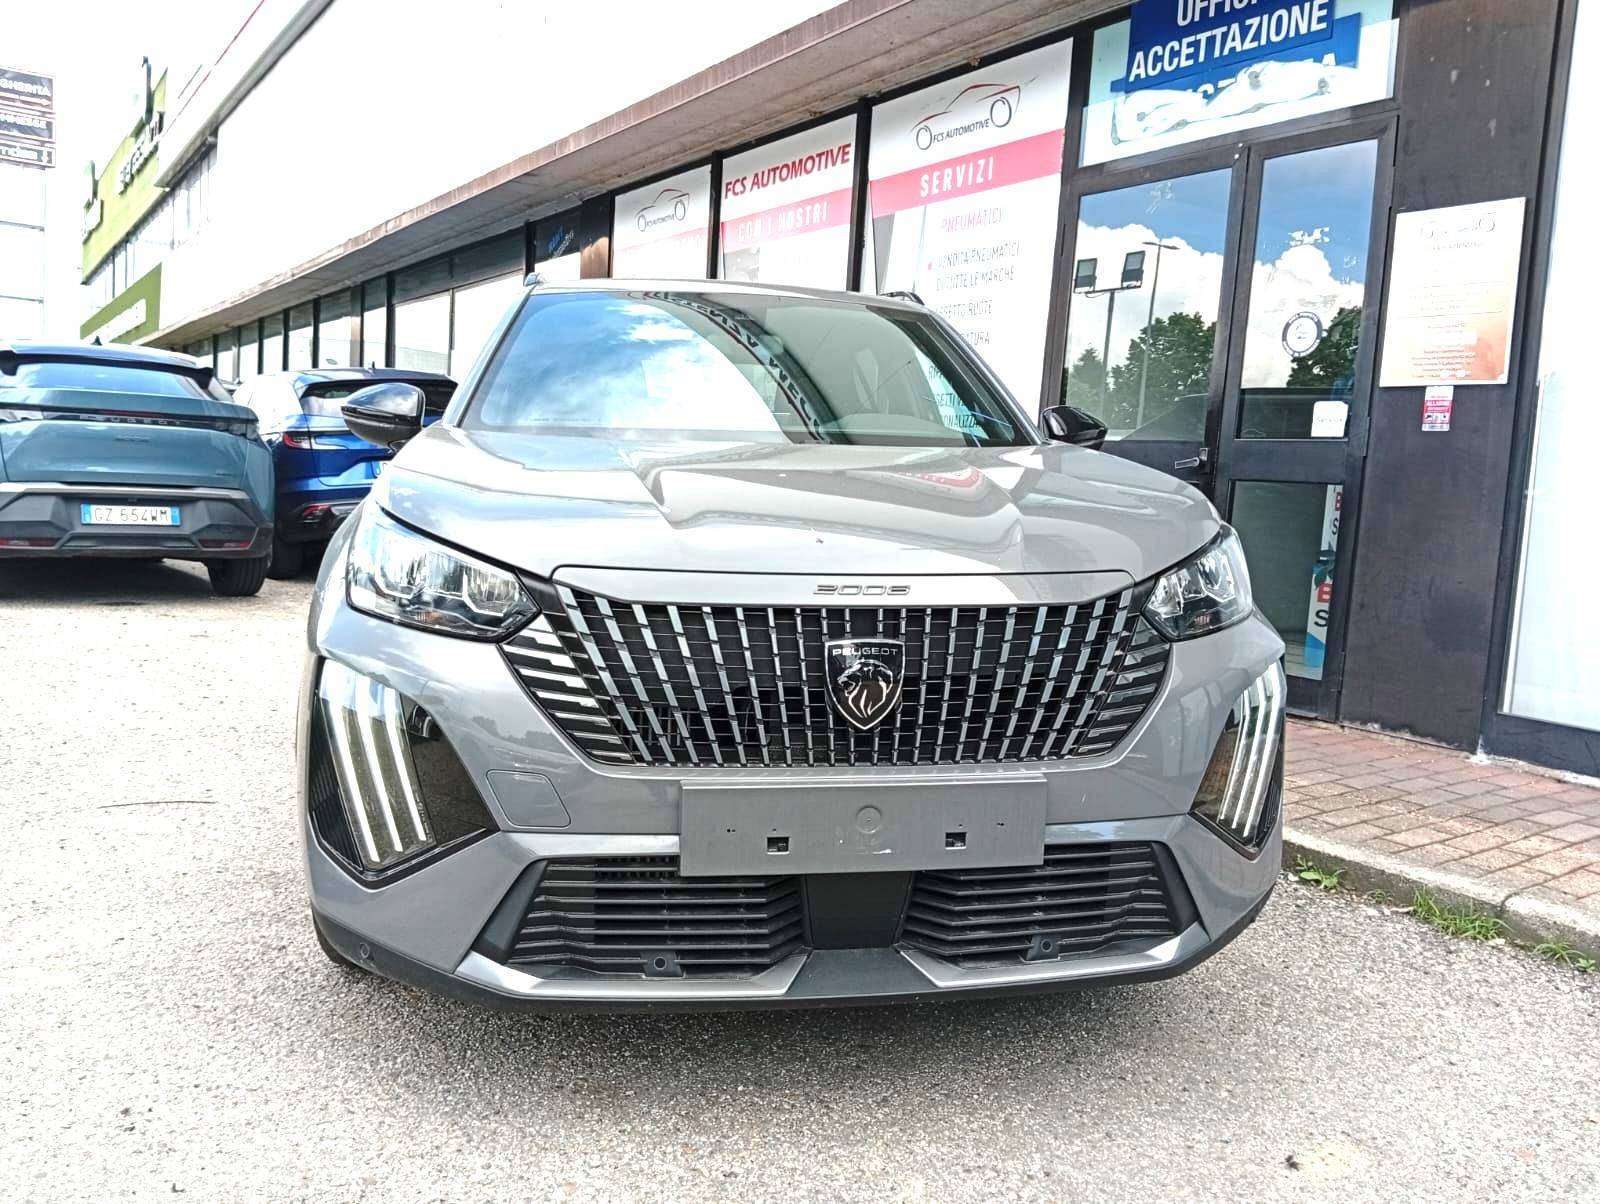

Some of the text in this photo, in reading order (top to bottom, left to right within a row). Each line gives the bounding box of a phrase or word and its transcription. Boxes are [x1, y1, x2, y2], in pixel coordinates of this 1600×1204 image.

[1177, 0, 1258, 27] UFF
[1128, 0, 1329, 82] ACCETTAZIONE
[933, 118, 990, 144] FCS AUTOMOTIVE
[724, 143, 852, 200] FCS AUTOMOTIVE
[920, 156, 995, 199] SERVIZI
[778, 201, 831, 232] NOSTRI
[94, 507, 113, 522] GZ
[813, 584, 911, 596] 2008
[832, 647, 899, 657] PEUGEOT
